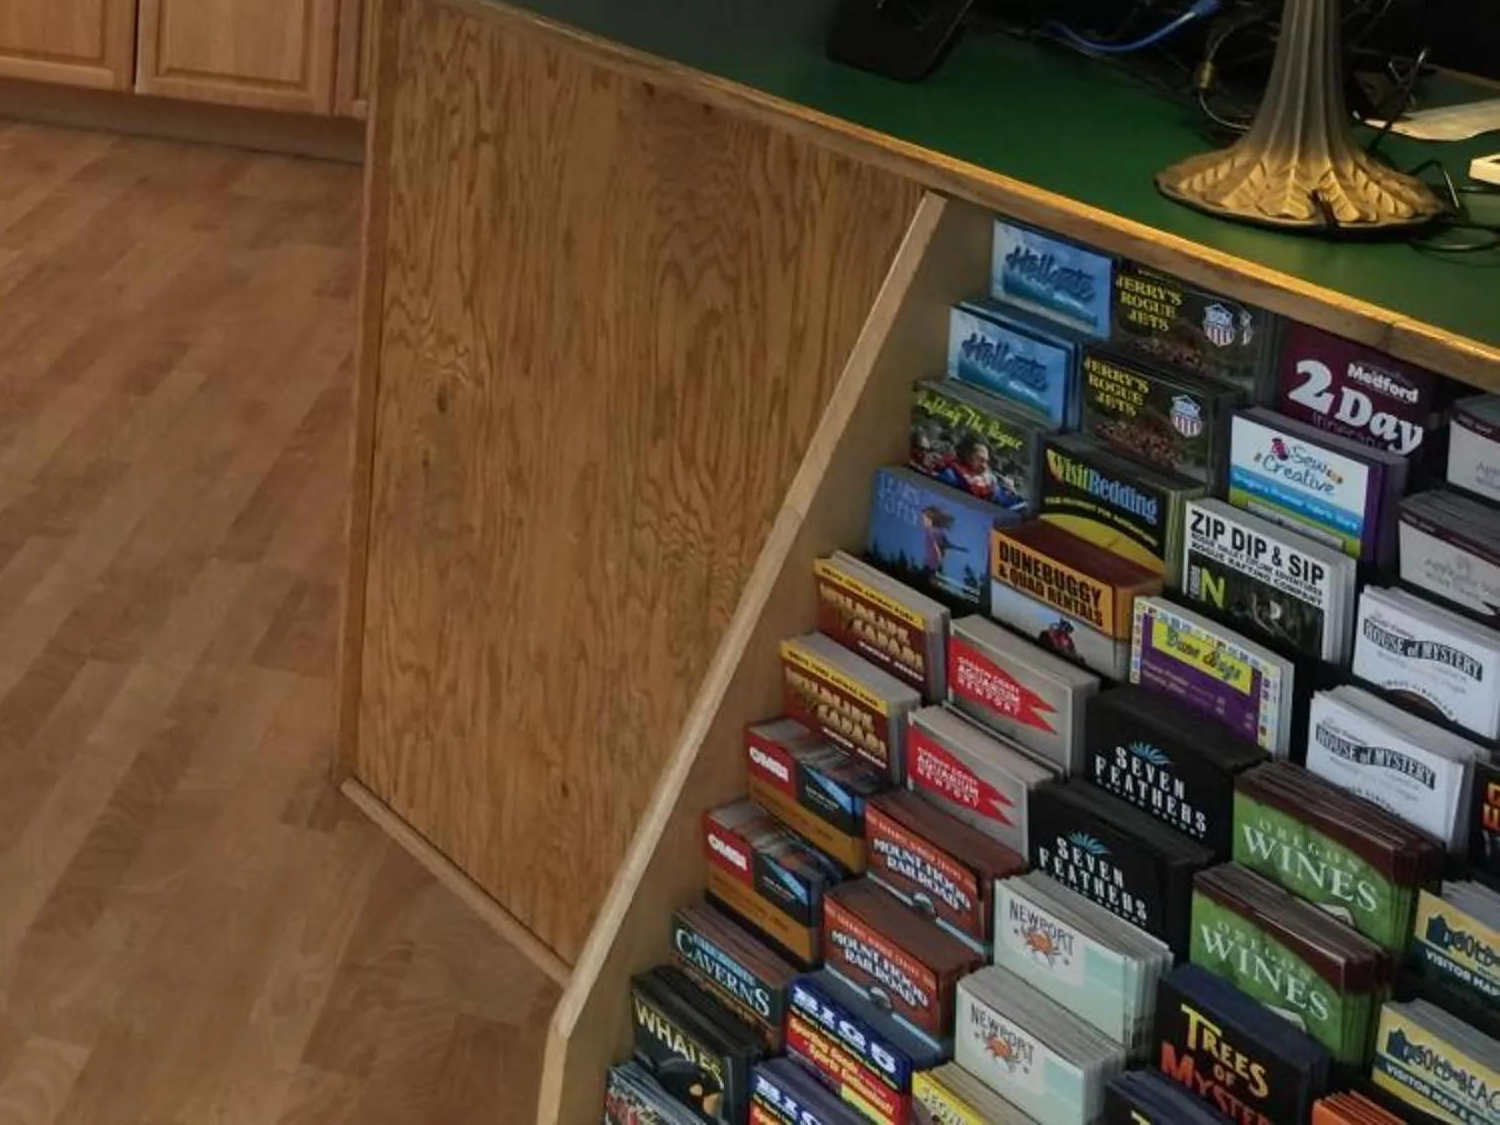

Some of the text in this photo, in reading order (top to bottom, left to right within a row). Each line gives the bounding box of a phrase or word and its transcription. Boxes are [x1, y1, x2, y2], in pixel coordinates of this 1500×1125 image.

[1116, 275, 1182, 306] JERRY'S
[1120, 291, 1176, 319] ROGUE
[1128, 310, 1170, 332] JETS
[1084, 356, 1149, 394] JERRY'S
[1088, 373, 1144, 407] ROGUE
[1347, 362, 1419, 404] Medford
[1095, 392, 1137, 417] JETS
[1288, 360, 1423, 456] 2 Day
[1190, 509, 1225, 541] ZIP
[1231, 527, 1267, 560] DIP
[1272, 545, 1282, 567] &
[1288, 554, 1324, 585] SIP
[1422, 642, 1482, 681] MYSTERY
[1095, 754, 1207, 833] FEATHERS
[1115, 746, 1185, 800] SEVEN
[1375, 747, 1436, 790] MYSTERY
[873, 838, 922, 869] MOUNT
[924, 863, 972, 910] HOOD
[887, 855, 961, 911] RAILROAD
[1039, 846, 1147, 921] FEATHERS
[1056, 836, 1124, 889] SEVEN
[1242, 823, 1377, 913] WINES
[1009, 899, 1075, 956] NEWPORT
[676, 928, 771, 1018] CAVERNS
[831, 930, 880, 964] MOUNT
[883, 958, 929, 1007] HOOD
[844, 948, 917, 1007] RAILROAD
[1201, 924, 1329, 1021] WINES
[1425, 948, 1472, 985] VISITOR
[970, 1005, 1035, 1064] NEWPORT
[1181, 1003, 1269, 1098] TREES
[1213, 1064, 1236, 1087] OF
[1386, 1063, 1432, 1097] VISITOR
